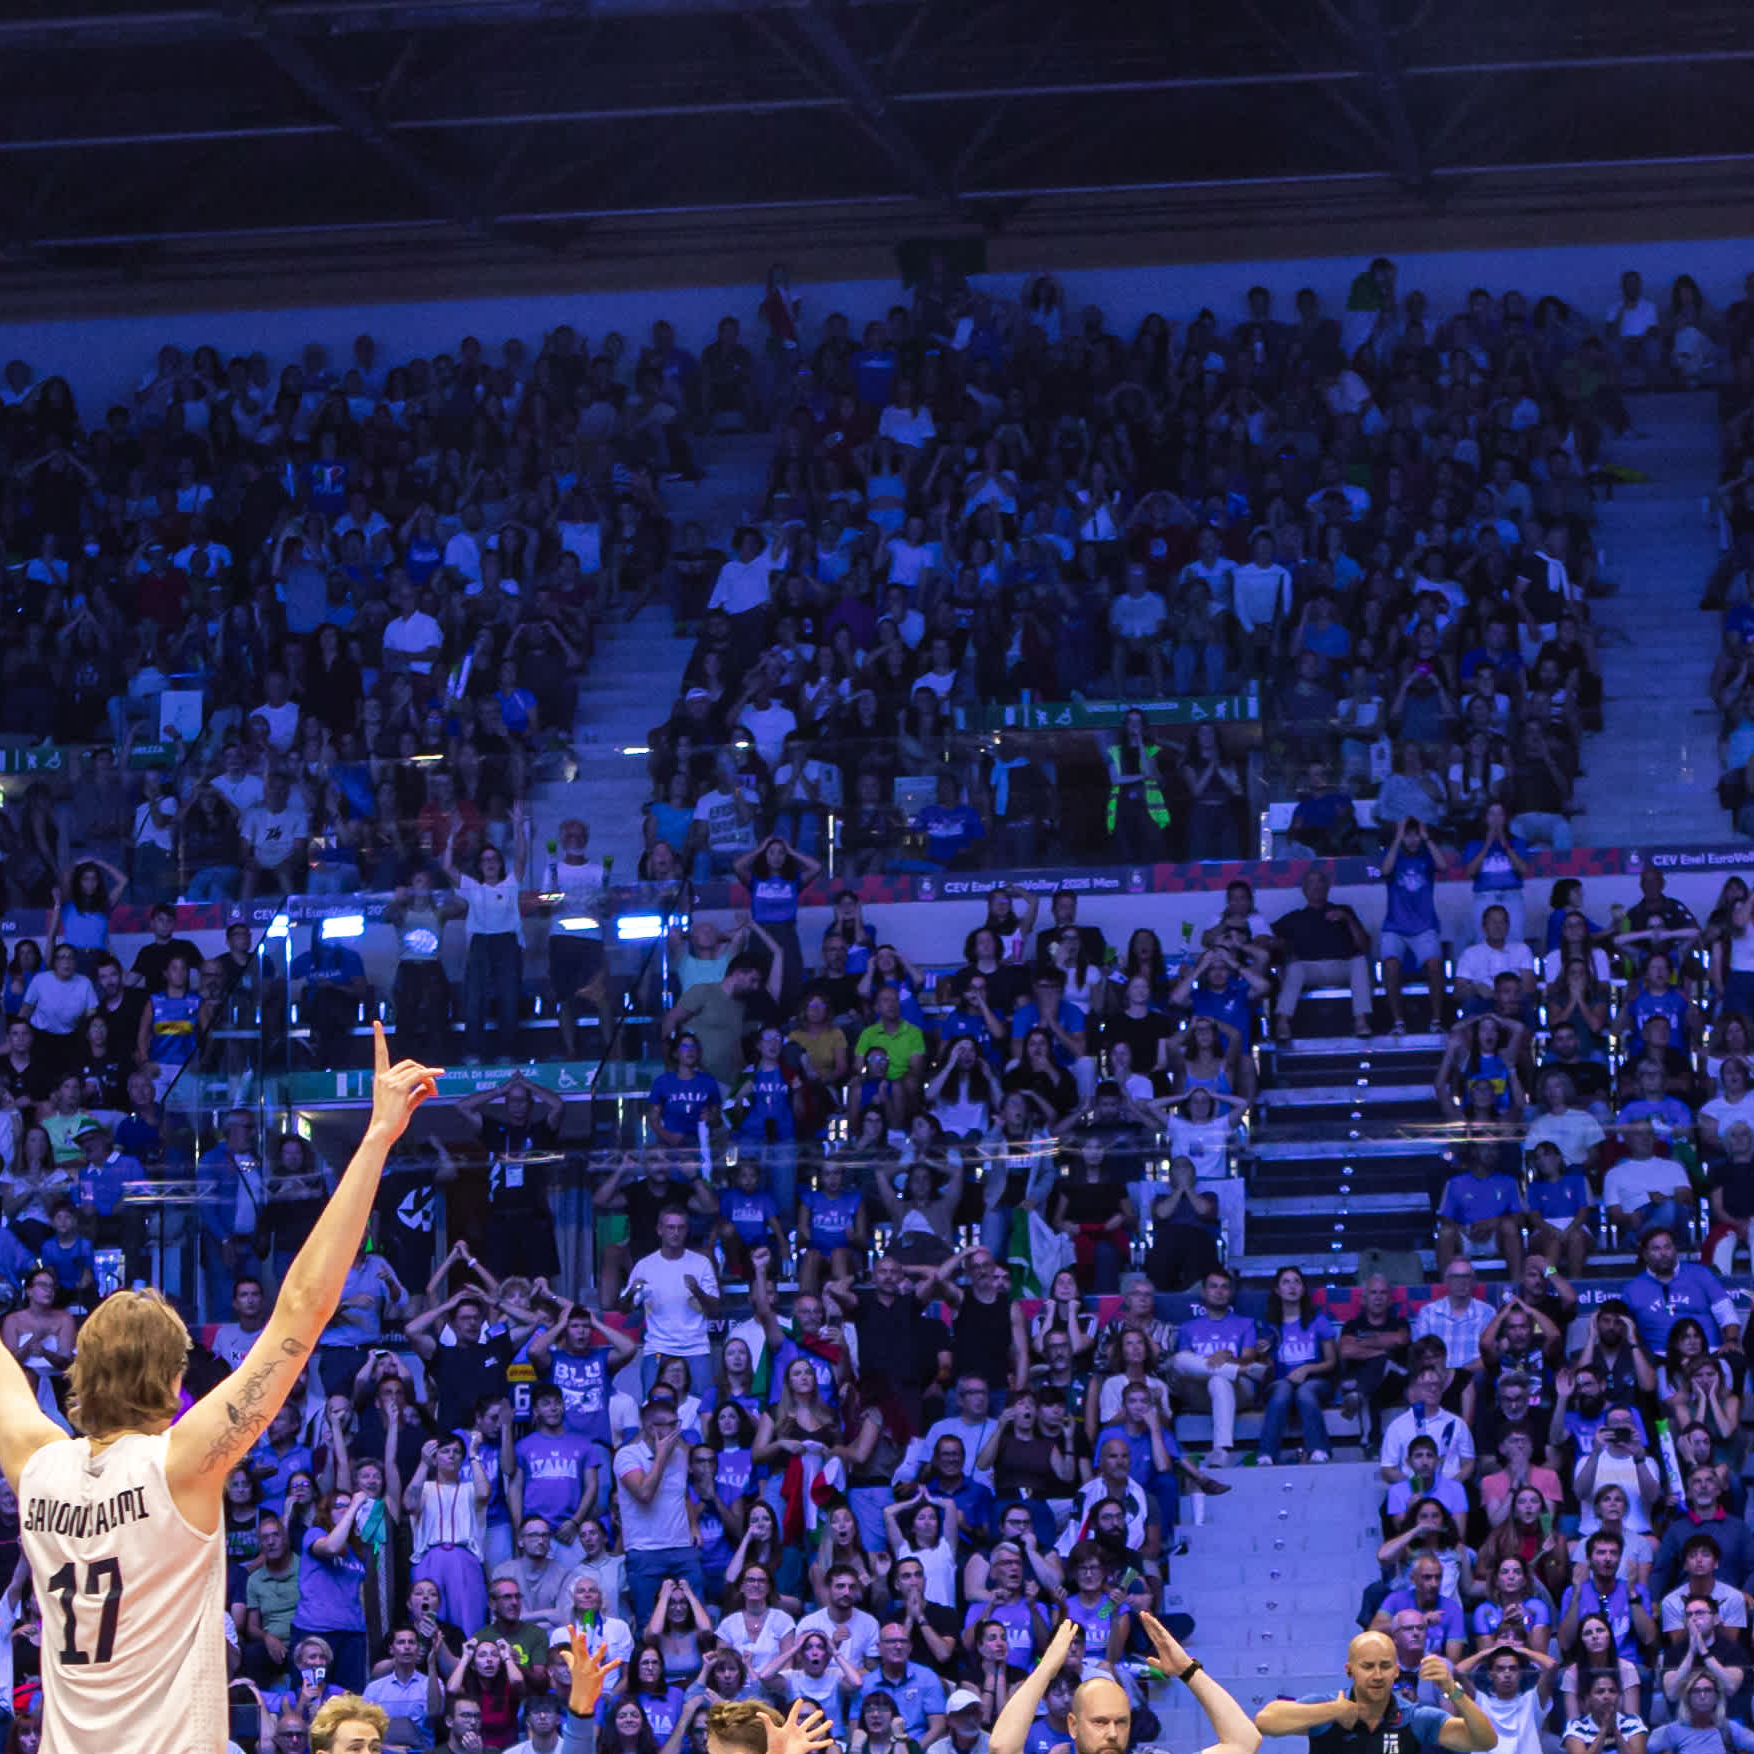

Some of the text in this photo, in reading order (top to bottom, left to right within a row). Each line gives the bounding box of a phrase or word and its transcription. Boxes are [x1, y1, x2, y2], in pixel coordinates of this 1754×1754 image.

[1653, 854, 1678, 866] CEV
[1680, 854, 1704, 865] Enel
[944, 882, 969, 893] CEV
[998, 880, 1060, 892] EVolley
[438, 1070, 468, 1081] SCITA
[47, 1556, 124, 1666] 17
